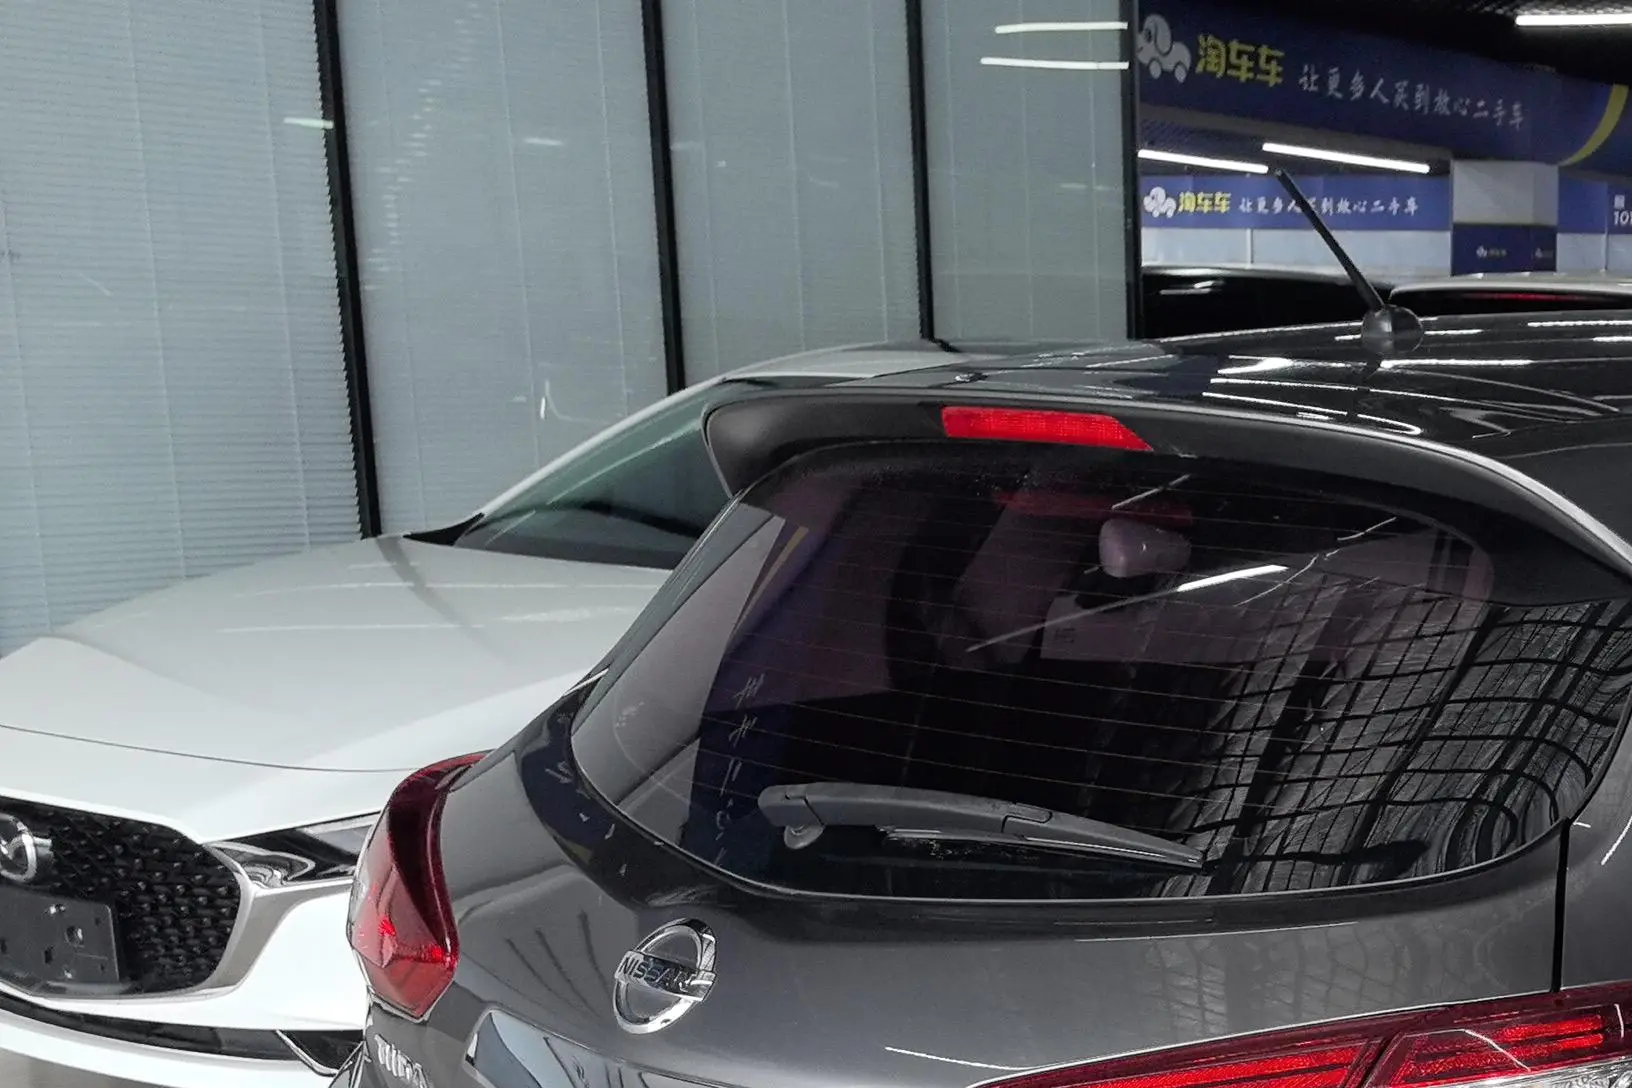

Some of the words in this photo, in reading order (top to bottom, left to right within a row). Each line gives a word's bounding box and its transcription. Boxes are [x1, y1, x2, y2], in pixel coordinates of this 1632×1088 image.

[1195, 33, 1286, 88] 淘车车
[1178, 190, 1231, 214] 淘车车
